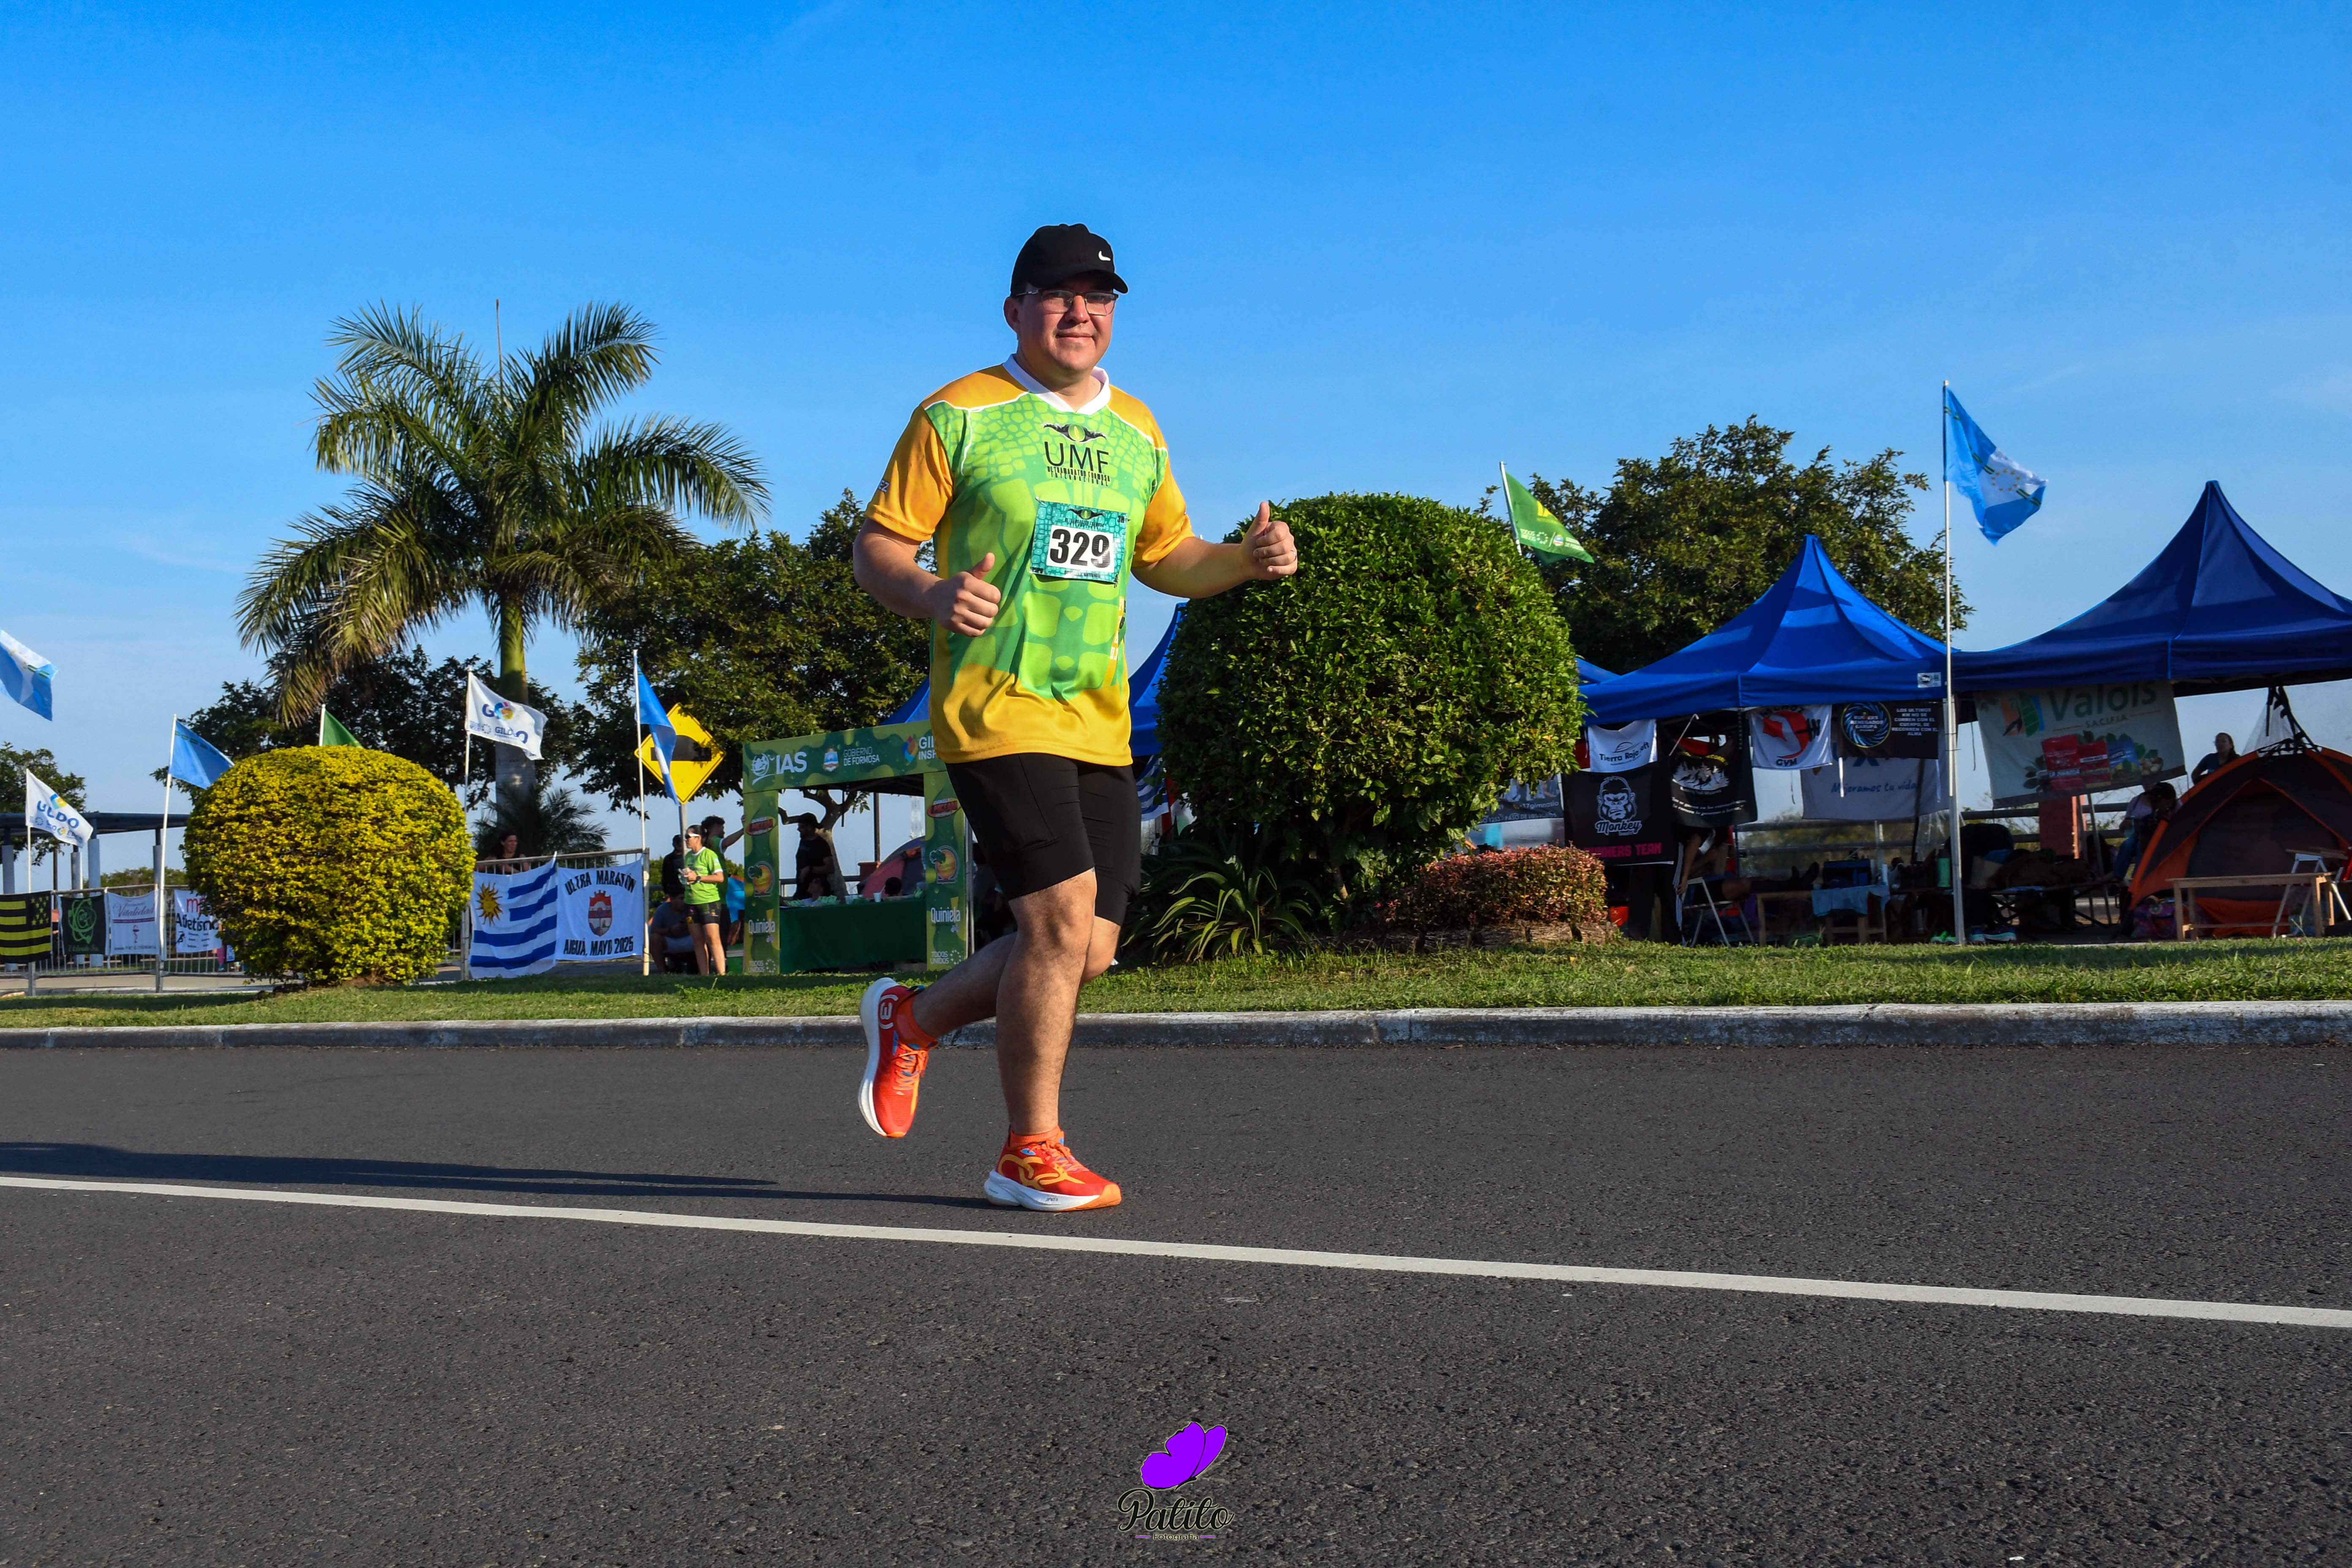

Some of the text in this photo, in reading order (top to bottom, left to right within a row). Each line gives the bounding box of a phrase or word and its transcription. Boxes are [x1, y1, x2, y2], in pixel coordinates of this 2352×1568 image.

[1044, 441, 1109, 473] UMF
[1050, 528, 1111, 568] 329
[2047, 681, 2157, 721] Valois
[844, 746, 872, 758] GOBIERNO
[844, 754, 880, 766] DE FORMOSA
[1599, 753, 1622, 762] Tierra
[776, 751, 807, 775] IAS
[1776, 757, 1797, 767] GYM
[1831, 782, 1881, 795] Mjoramos
[1595, 818, 1642, 836] Monkey
[1635, 842, 1662, 856] TEAM
[565, 870, 636, 895] ULTRA MARATÓN
[931, 906, 961, 923] Quiniela
[748, 918, 776, 934] Quiniela
[590, 939, 612, 956] MAYO
[614, 936, 634, 954] 2025
